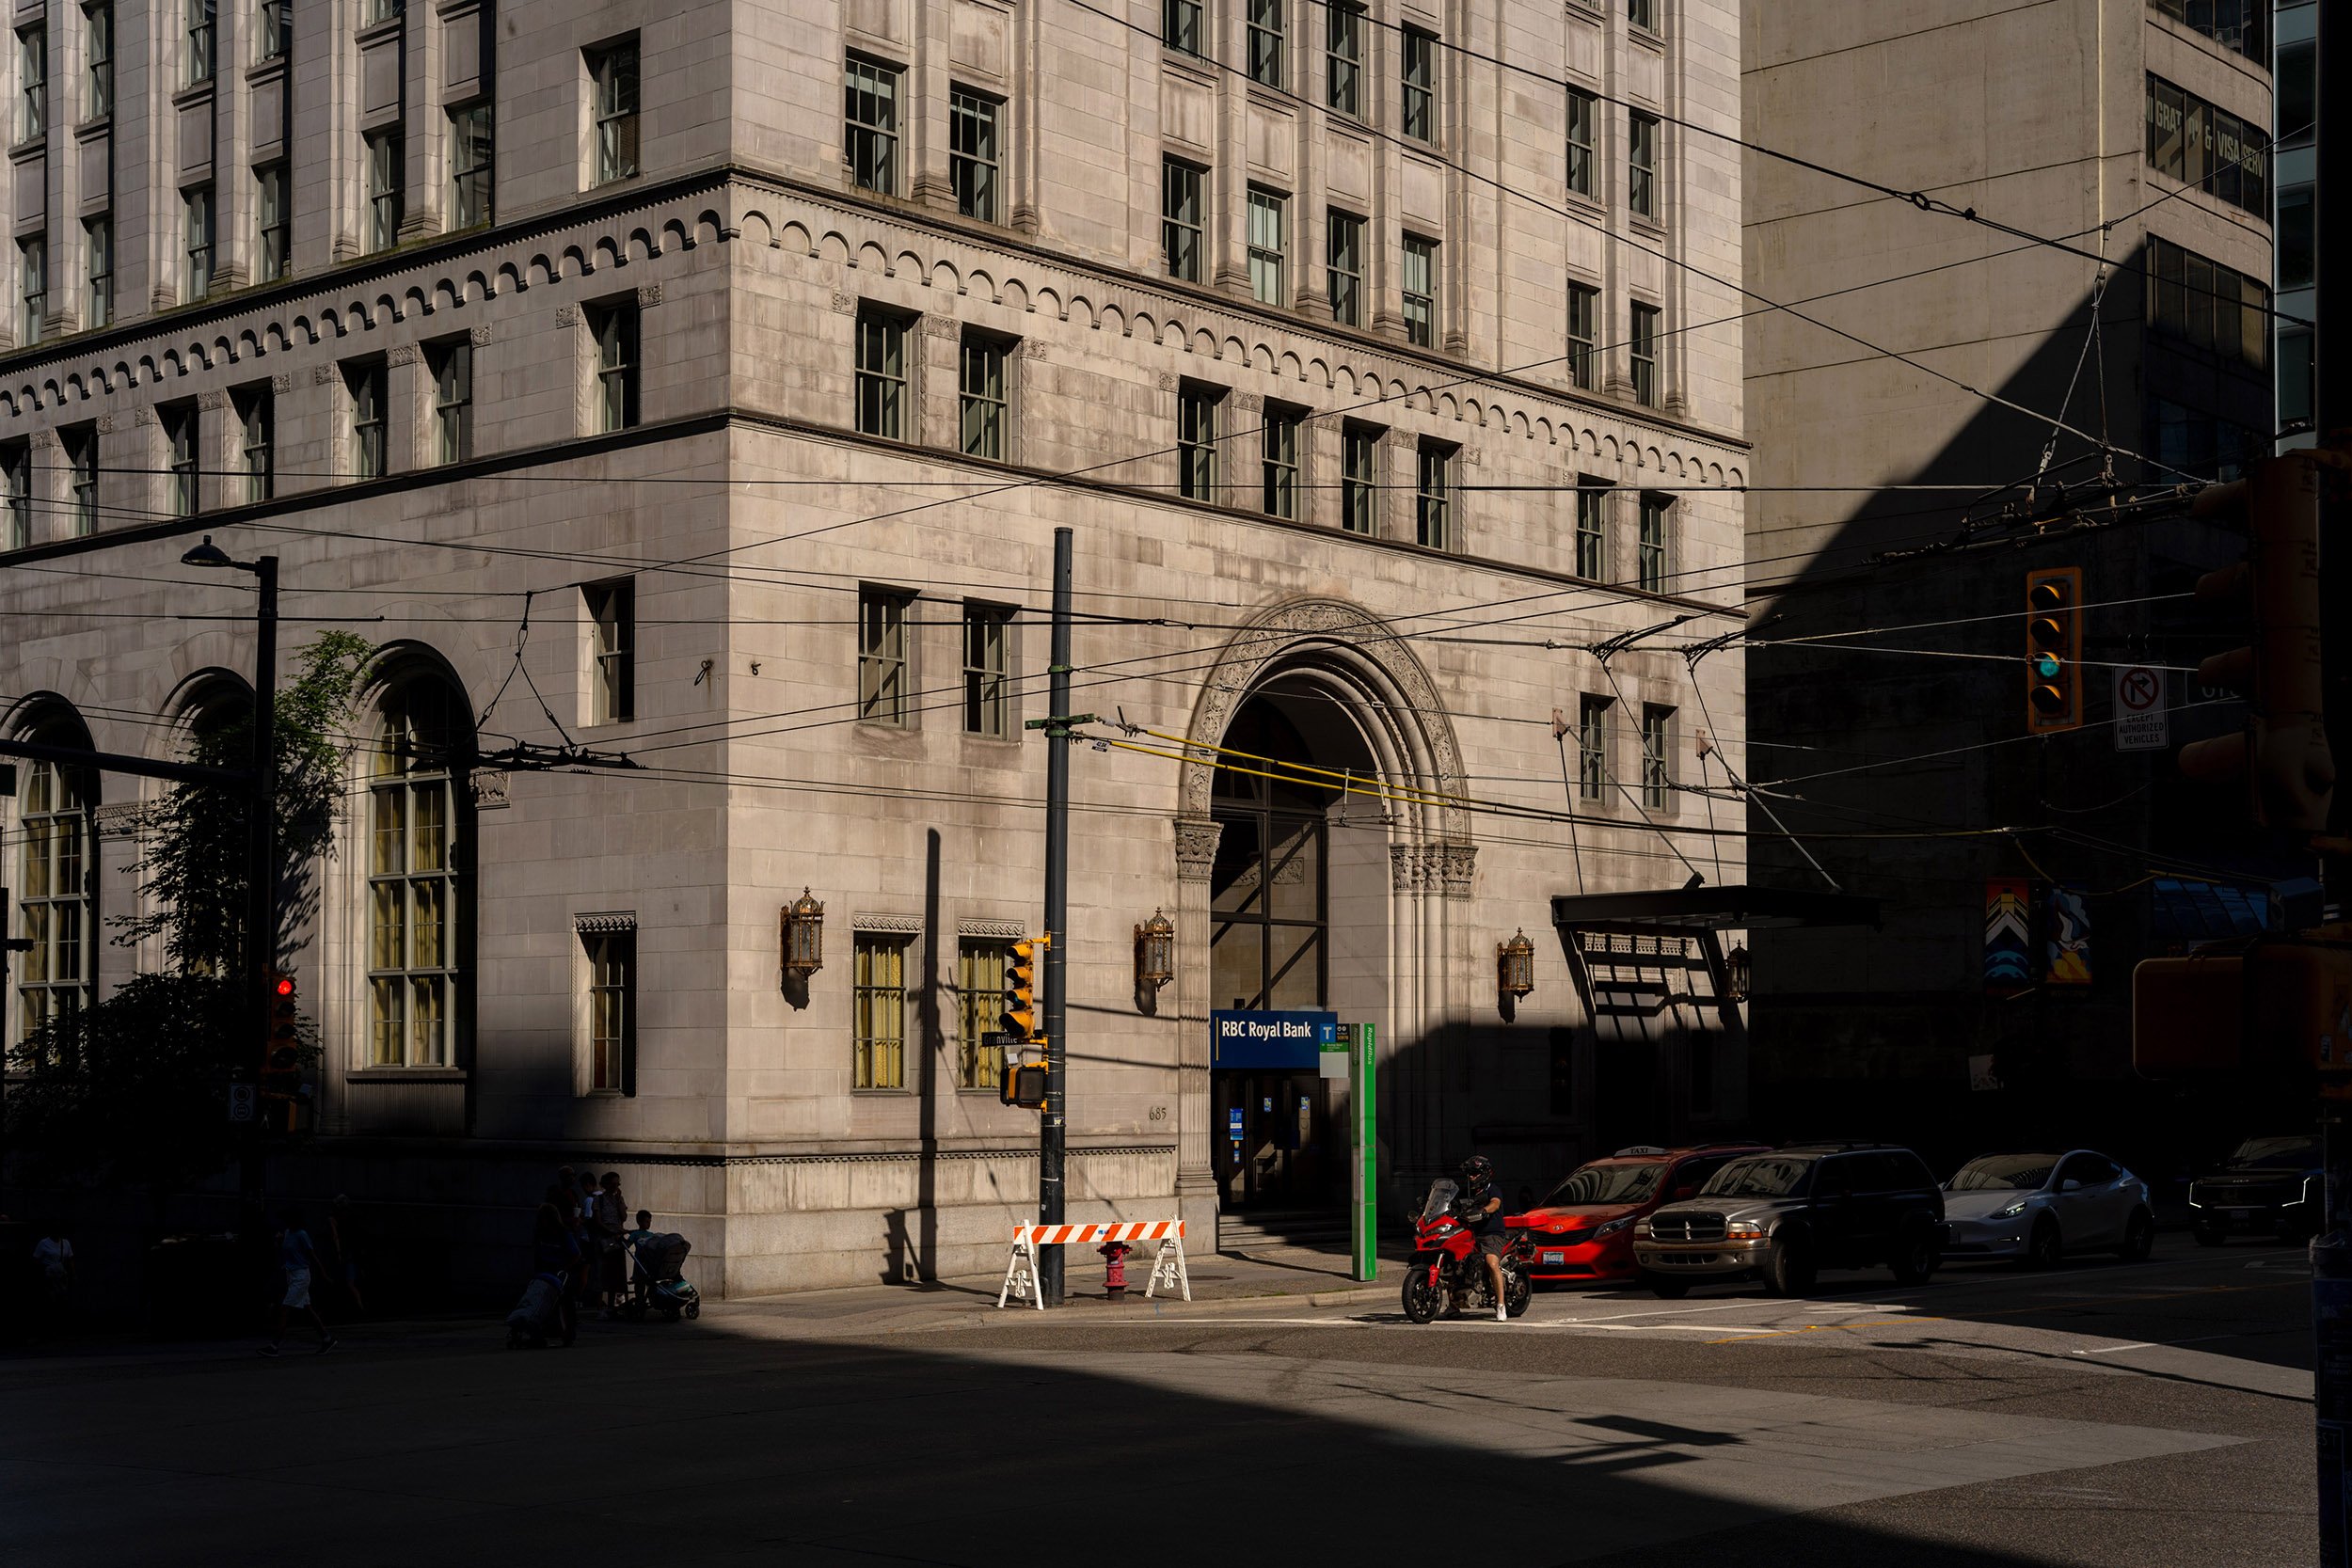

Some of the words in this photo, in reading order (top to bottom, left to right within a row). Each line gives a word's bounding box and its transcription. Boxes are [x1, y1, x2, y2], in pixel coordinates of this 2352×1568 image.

[2217, 130, 2241, 166] VISA
[2119, 722, 2164, 735] AUTHORIZED
[2123, 734, 2160, 745] VEHICLES
[1221, 1021, 1246, 1037] RBC
[1248, 1021, 1280, 1042] Royal
[1283, 1021, 1312, 1037] Bank
[1323, 1026, 1332, 1040] T
[1149, 1106, 1167, 1120] 685
